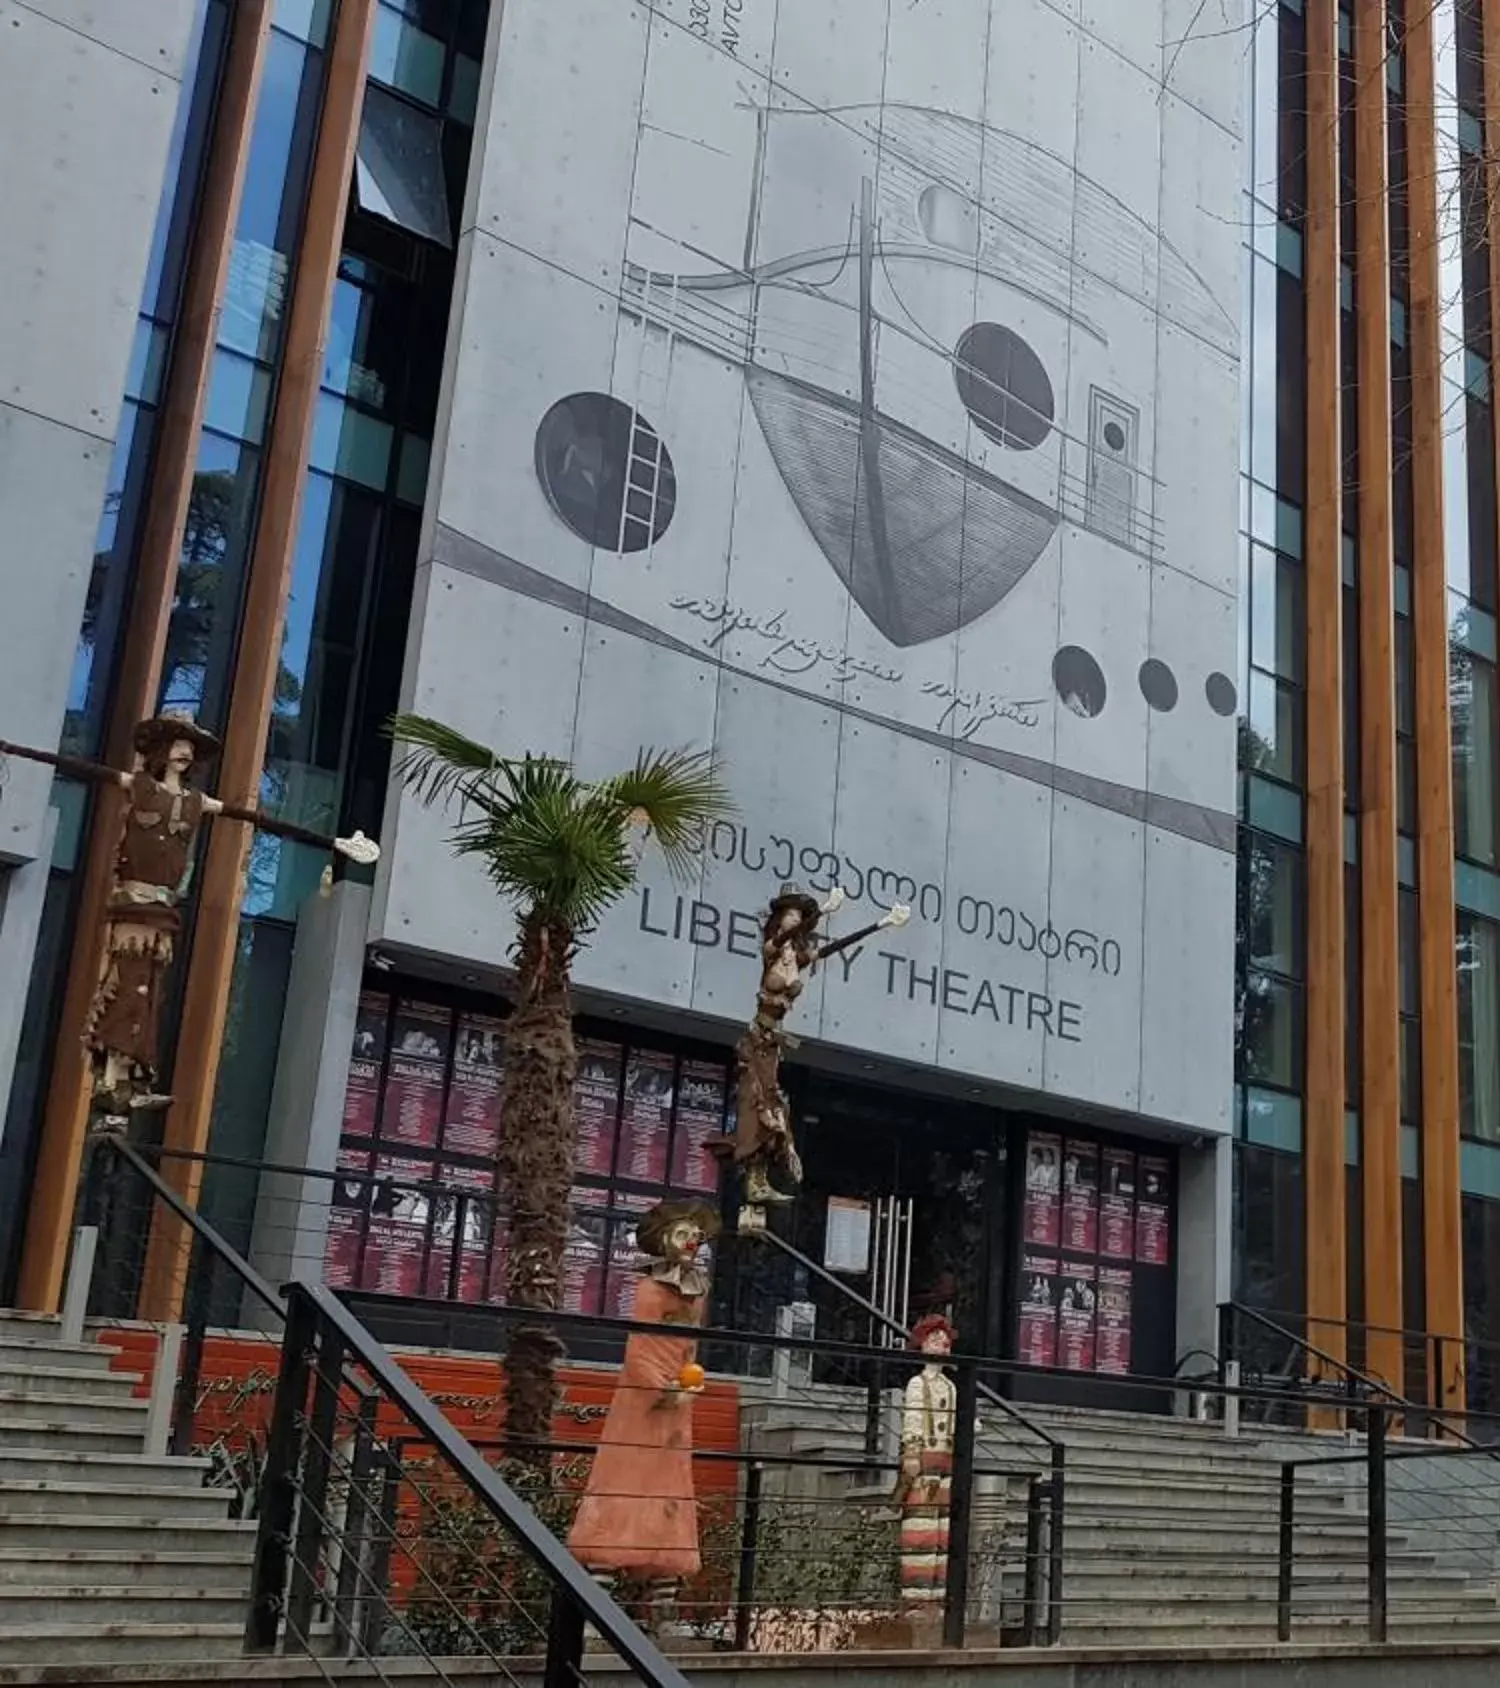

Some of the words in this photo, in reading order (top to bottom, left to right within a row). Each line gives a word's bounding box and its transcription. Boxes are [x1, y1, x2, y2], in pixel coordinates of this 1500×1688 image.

[639, 886, 864, 983] LIBETY
[878, 950, 1083, 1043] THEATRE
[957, 895, 1121, 977] თეატრი
